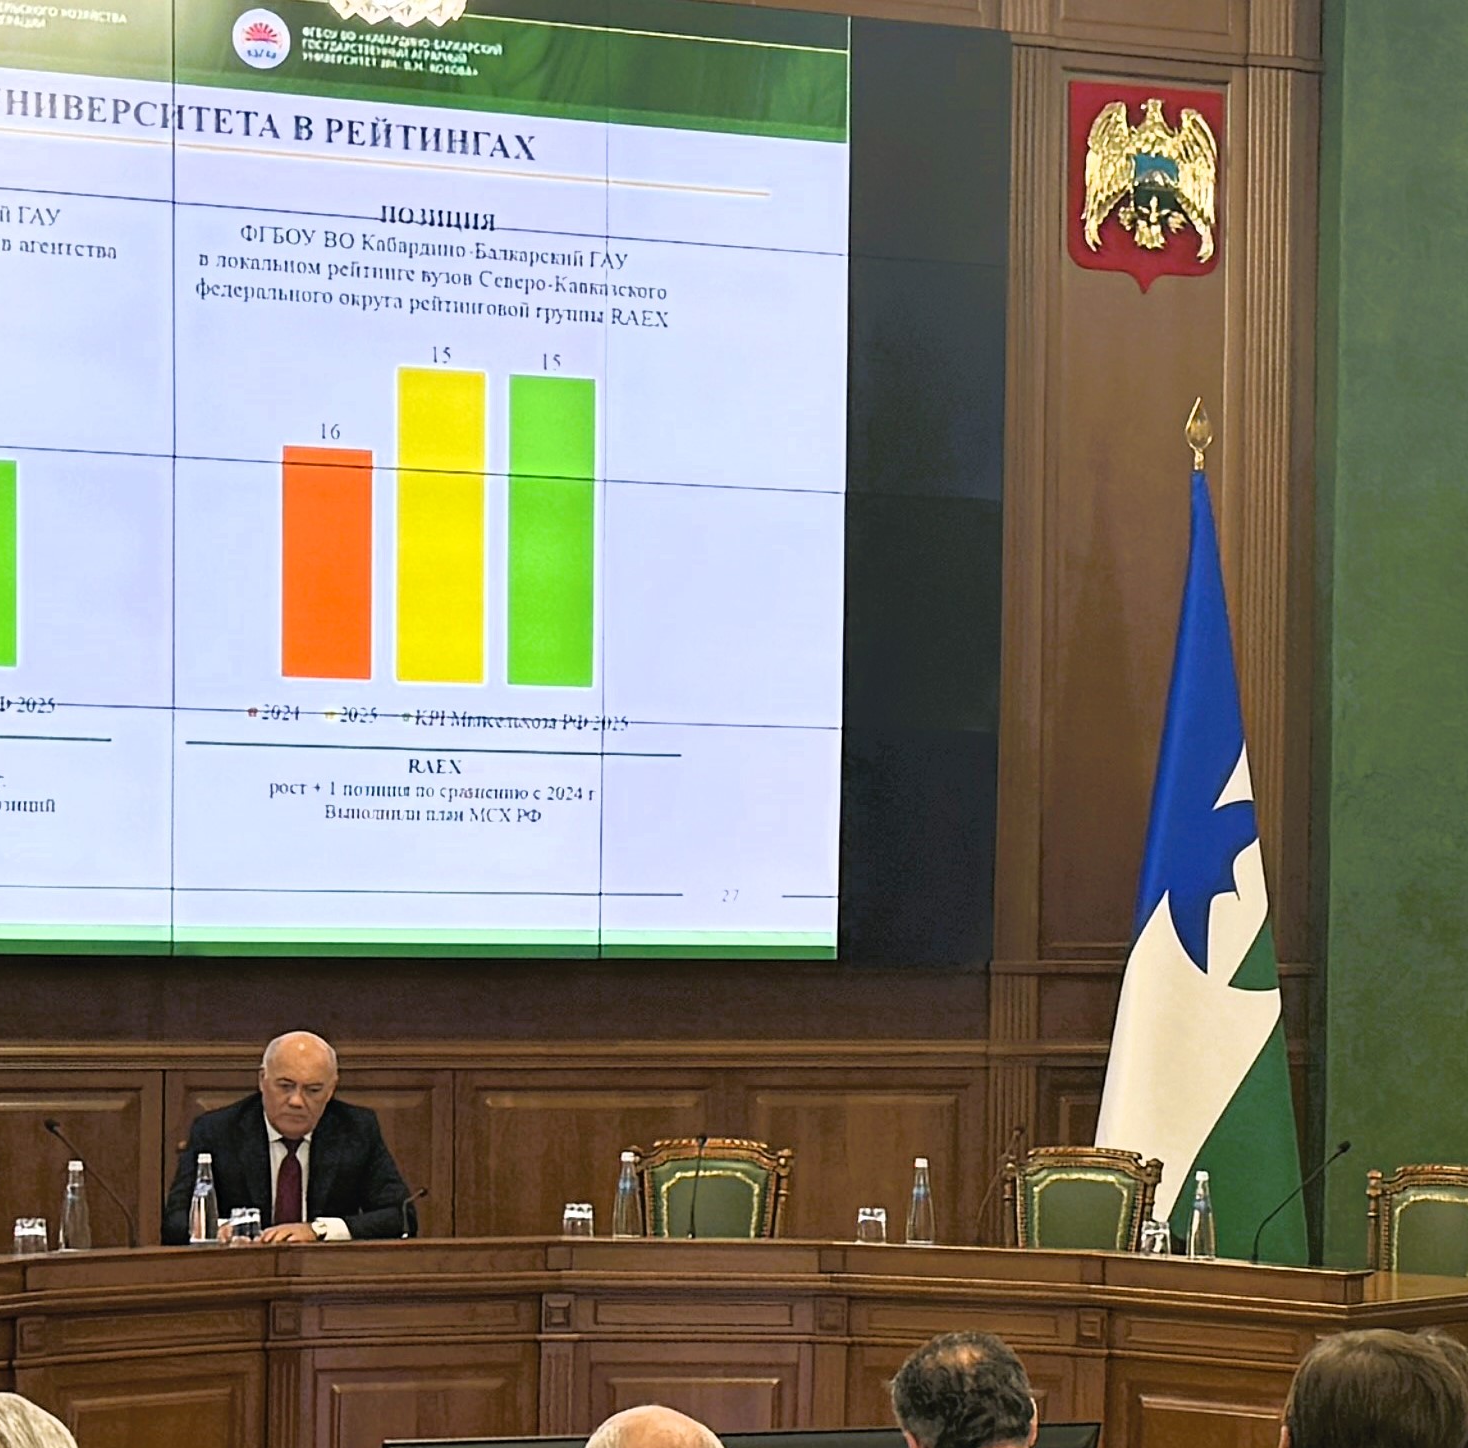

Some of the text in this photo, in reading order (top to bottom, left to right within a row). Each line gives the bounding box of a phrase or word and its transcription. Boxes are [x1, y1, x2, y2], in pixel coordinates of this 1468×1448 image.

[294, 115, 313, 141] В
[325, 116, 536, 161] РЕЙТИНГАХ
[19, 206, 61, 226] ГАУ
[380, 205, 496, 233] ПОЗИЦИЯ
[19, 240, 117, 260] агентства
[240, 225, 628, 270] ФГБОУ ВО Кабардино-Балкарский ГАУ
[199, 254, 667, 300] в локальном рейтинге вузов Северо-Кавказского
[195, 277, 669, 328] федерального округа рейтинговой группы RAEX
[431, 346, 451, 364] 15
[542, 353, 561, 371] 15
[320, 423, 341, 441] 16
[16, 697, 56, 714] 2025
[261, 704, 300, 721] 2024
[339, 706, 378, 723] 2025
[415, 709, 445, 727] KPI
[562, 714, 588, 731] РФ
[408, 758, 462, 775] RAEX
[269, 782, 307, 799] рост
[416, 786, 435, 799] по
[440, 787, 529, 803] сравнению
[533, 789, 541, 801] с
[546, 786, 583, 801] 2024
[324, 804, 542, 823] Выполнили план МСХ РФ
